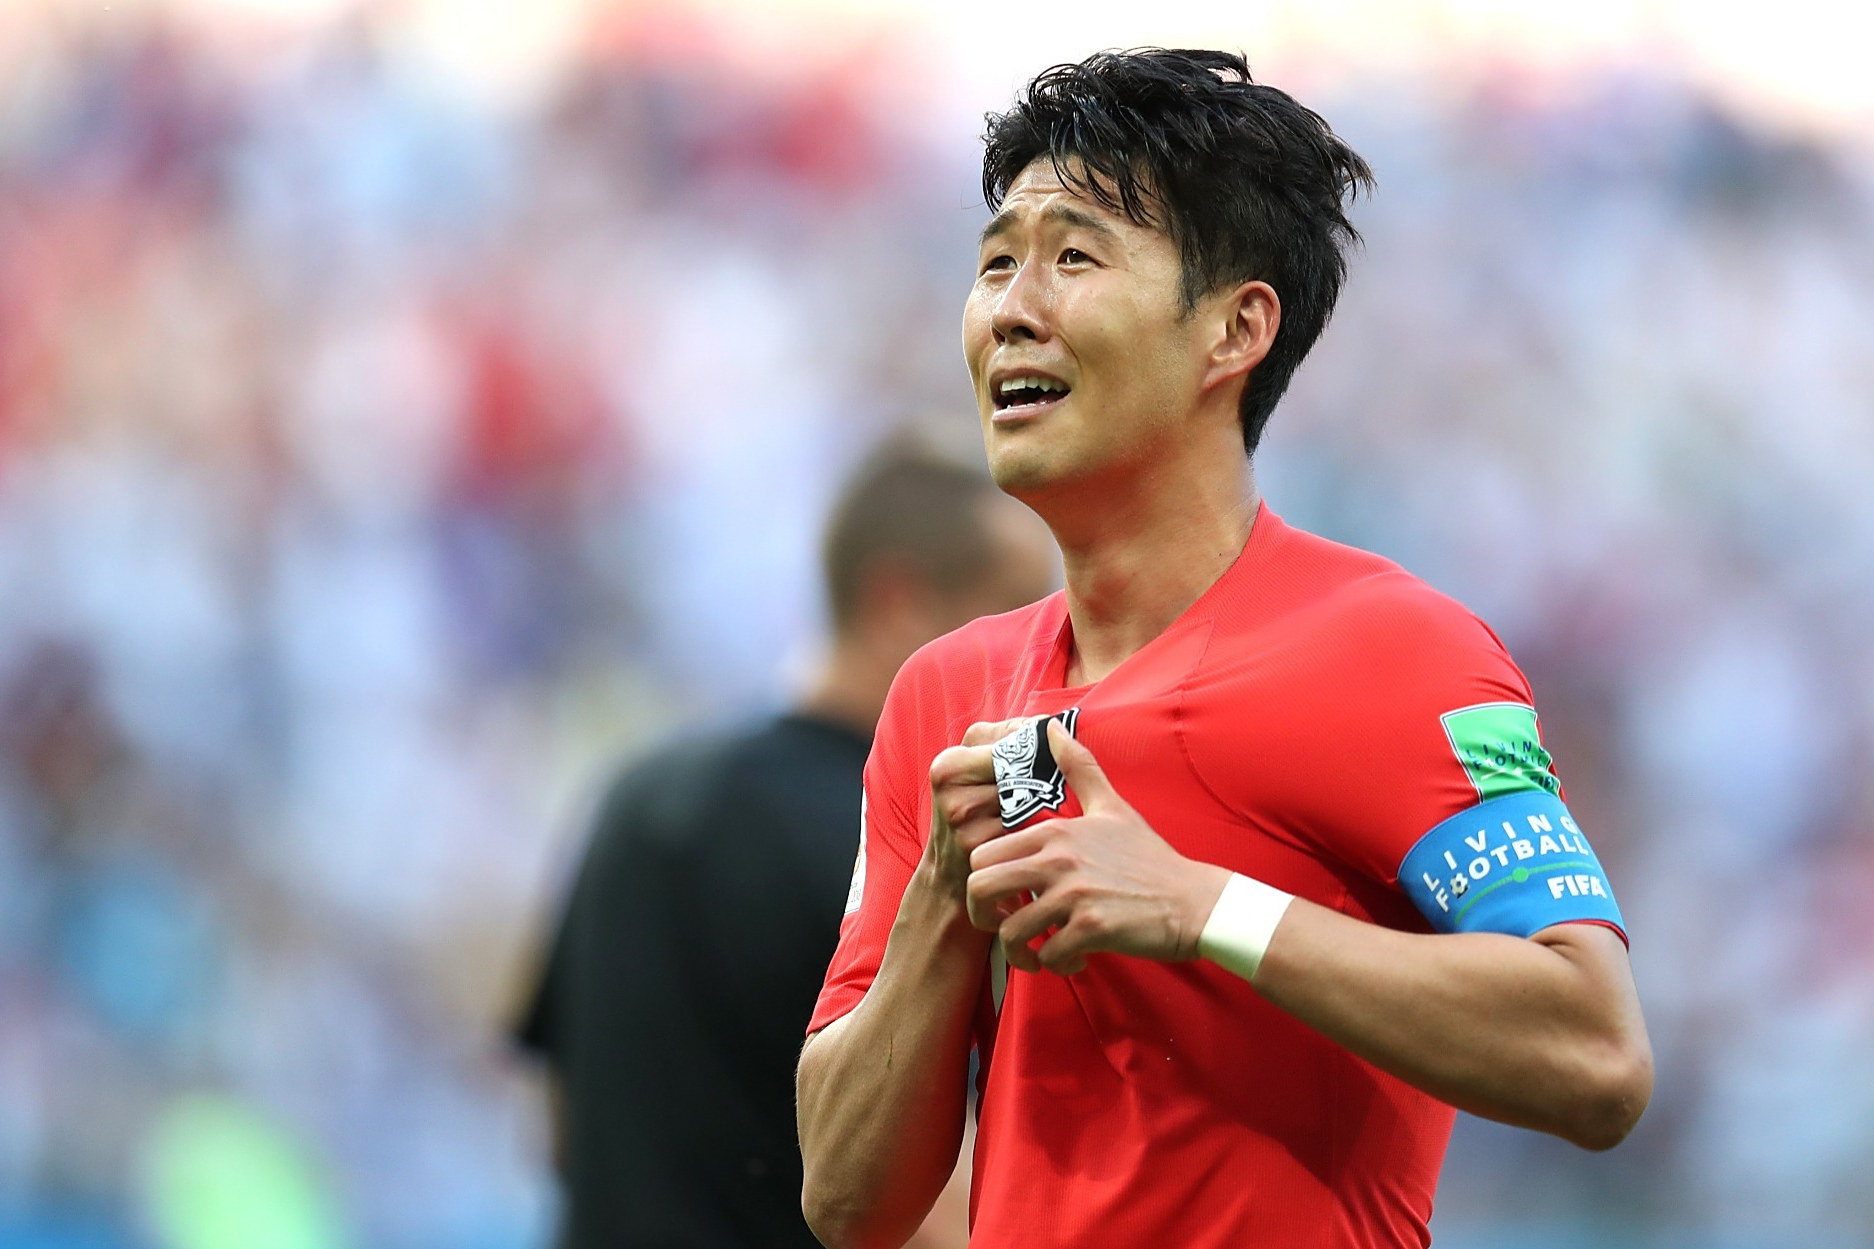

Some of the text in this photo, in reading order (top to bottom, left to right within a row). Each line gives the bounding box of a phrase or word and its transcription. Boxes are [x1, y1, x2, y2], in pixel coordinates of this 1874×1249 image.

[1422, 815, 1580, 892] LIVING
[1435, 834, 1589, 913] FOOTBALL
[1547, 875, 1607, 900] FIFA
